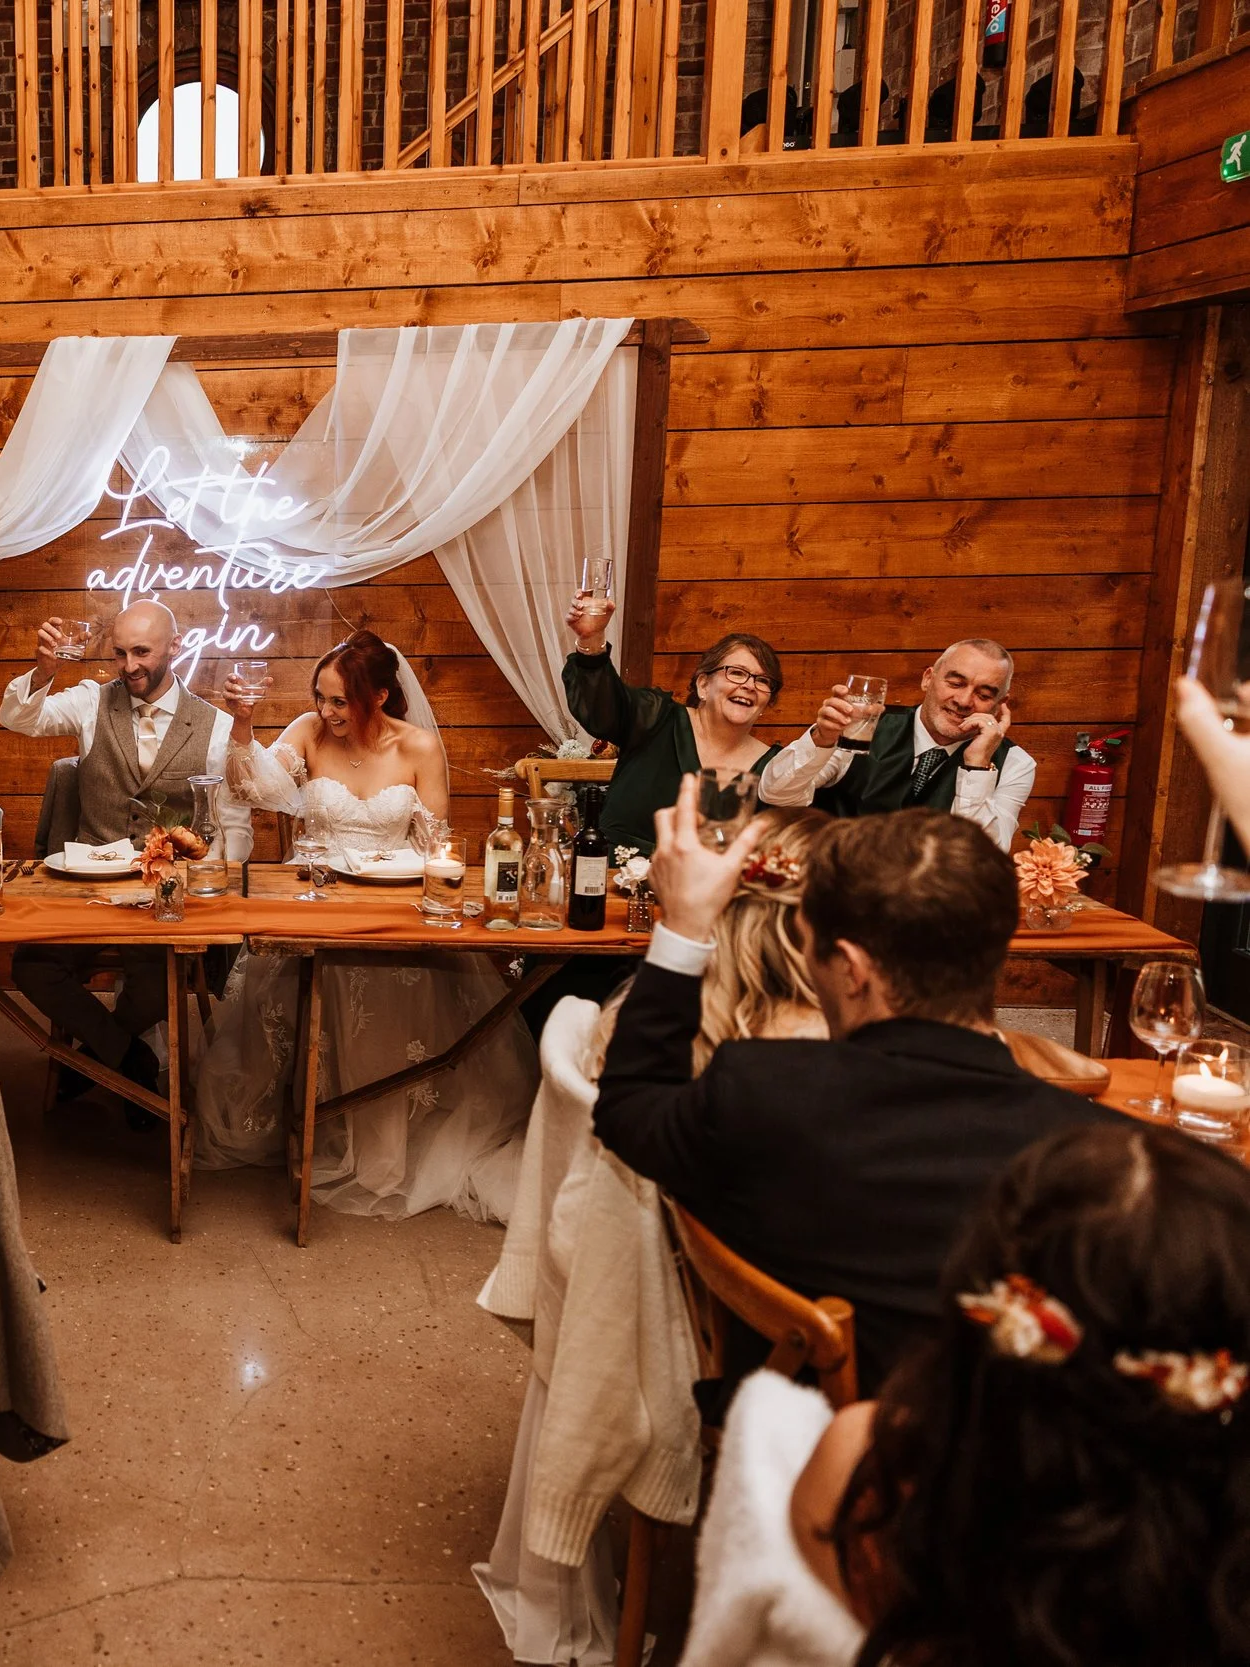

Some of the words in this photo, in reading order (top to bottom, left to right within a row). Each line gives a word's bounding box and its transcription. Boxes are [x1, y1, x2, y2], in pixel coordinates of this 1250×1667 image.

[101, 446, 230, 540] Let
[203, 461, 309, 528] the
[86, 533, 329, 611] adventure
[170, 613, 276, 688] gin
